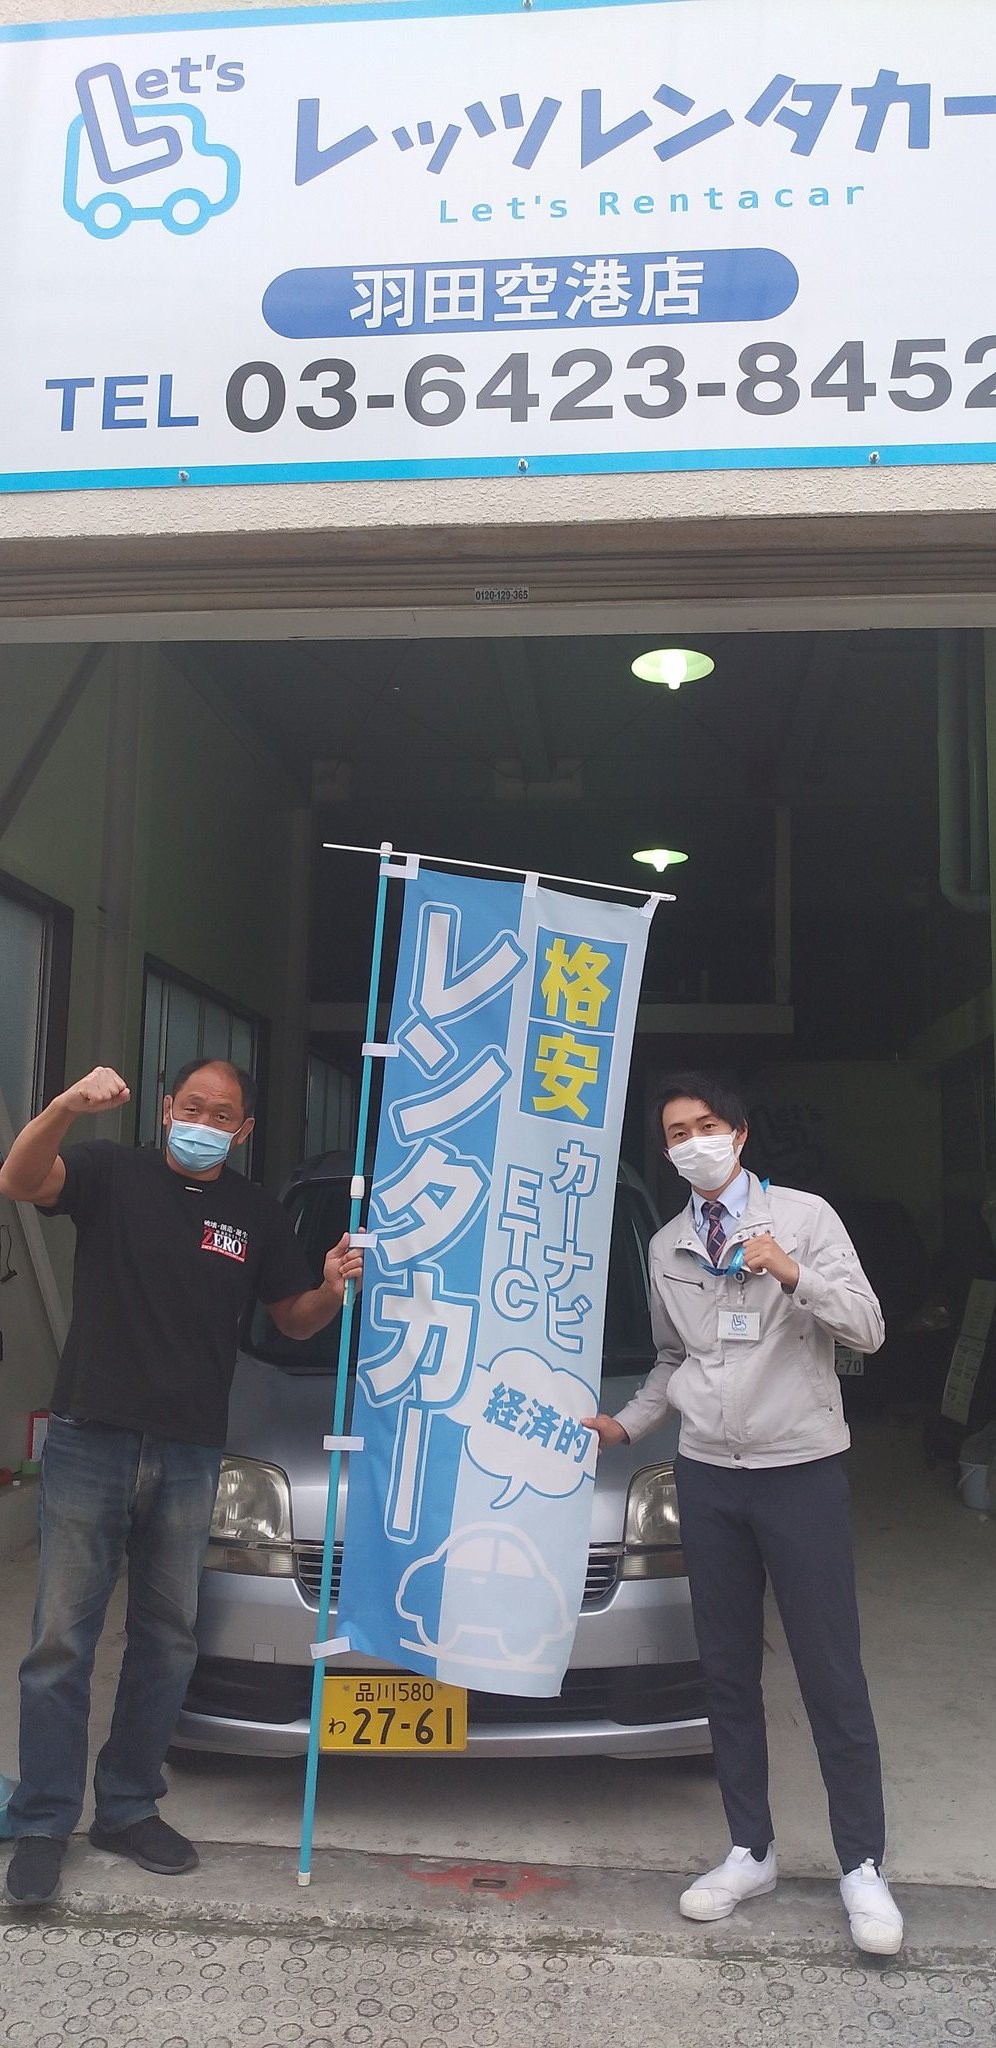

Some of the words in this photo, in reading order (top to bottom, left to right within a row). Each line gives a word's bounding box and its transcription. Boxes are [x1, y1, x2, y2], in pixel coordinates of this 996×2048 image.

[75, 54, 246, 184] Let's
[294, 68, 996, 186] レッツレンタカー
[439, 195, 568, 224] Let's
[598, 184, 865, 215] Rentacar
[348, 255, 704, 329] 羽田空港店
[45, 373, 199, 432] TEL
[532, 938, 612, 1121] 格安
[360, 904, 525, 1542] レンタカー
[490, 1164, 543, 1323] ETC
[542, 1140, 601, 1355] カーナビ
[482, 1381, 594, 1464] 経済的
[328, 1717, 347, 1735] わ
[352, 1707, 453, 1745] 27-61
